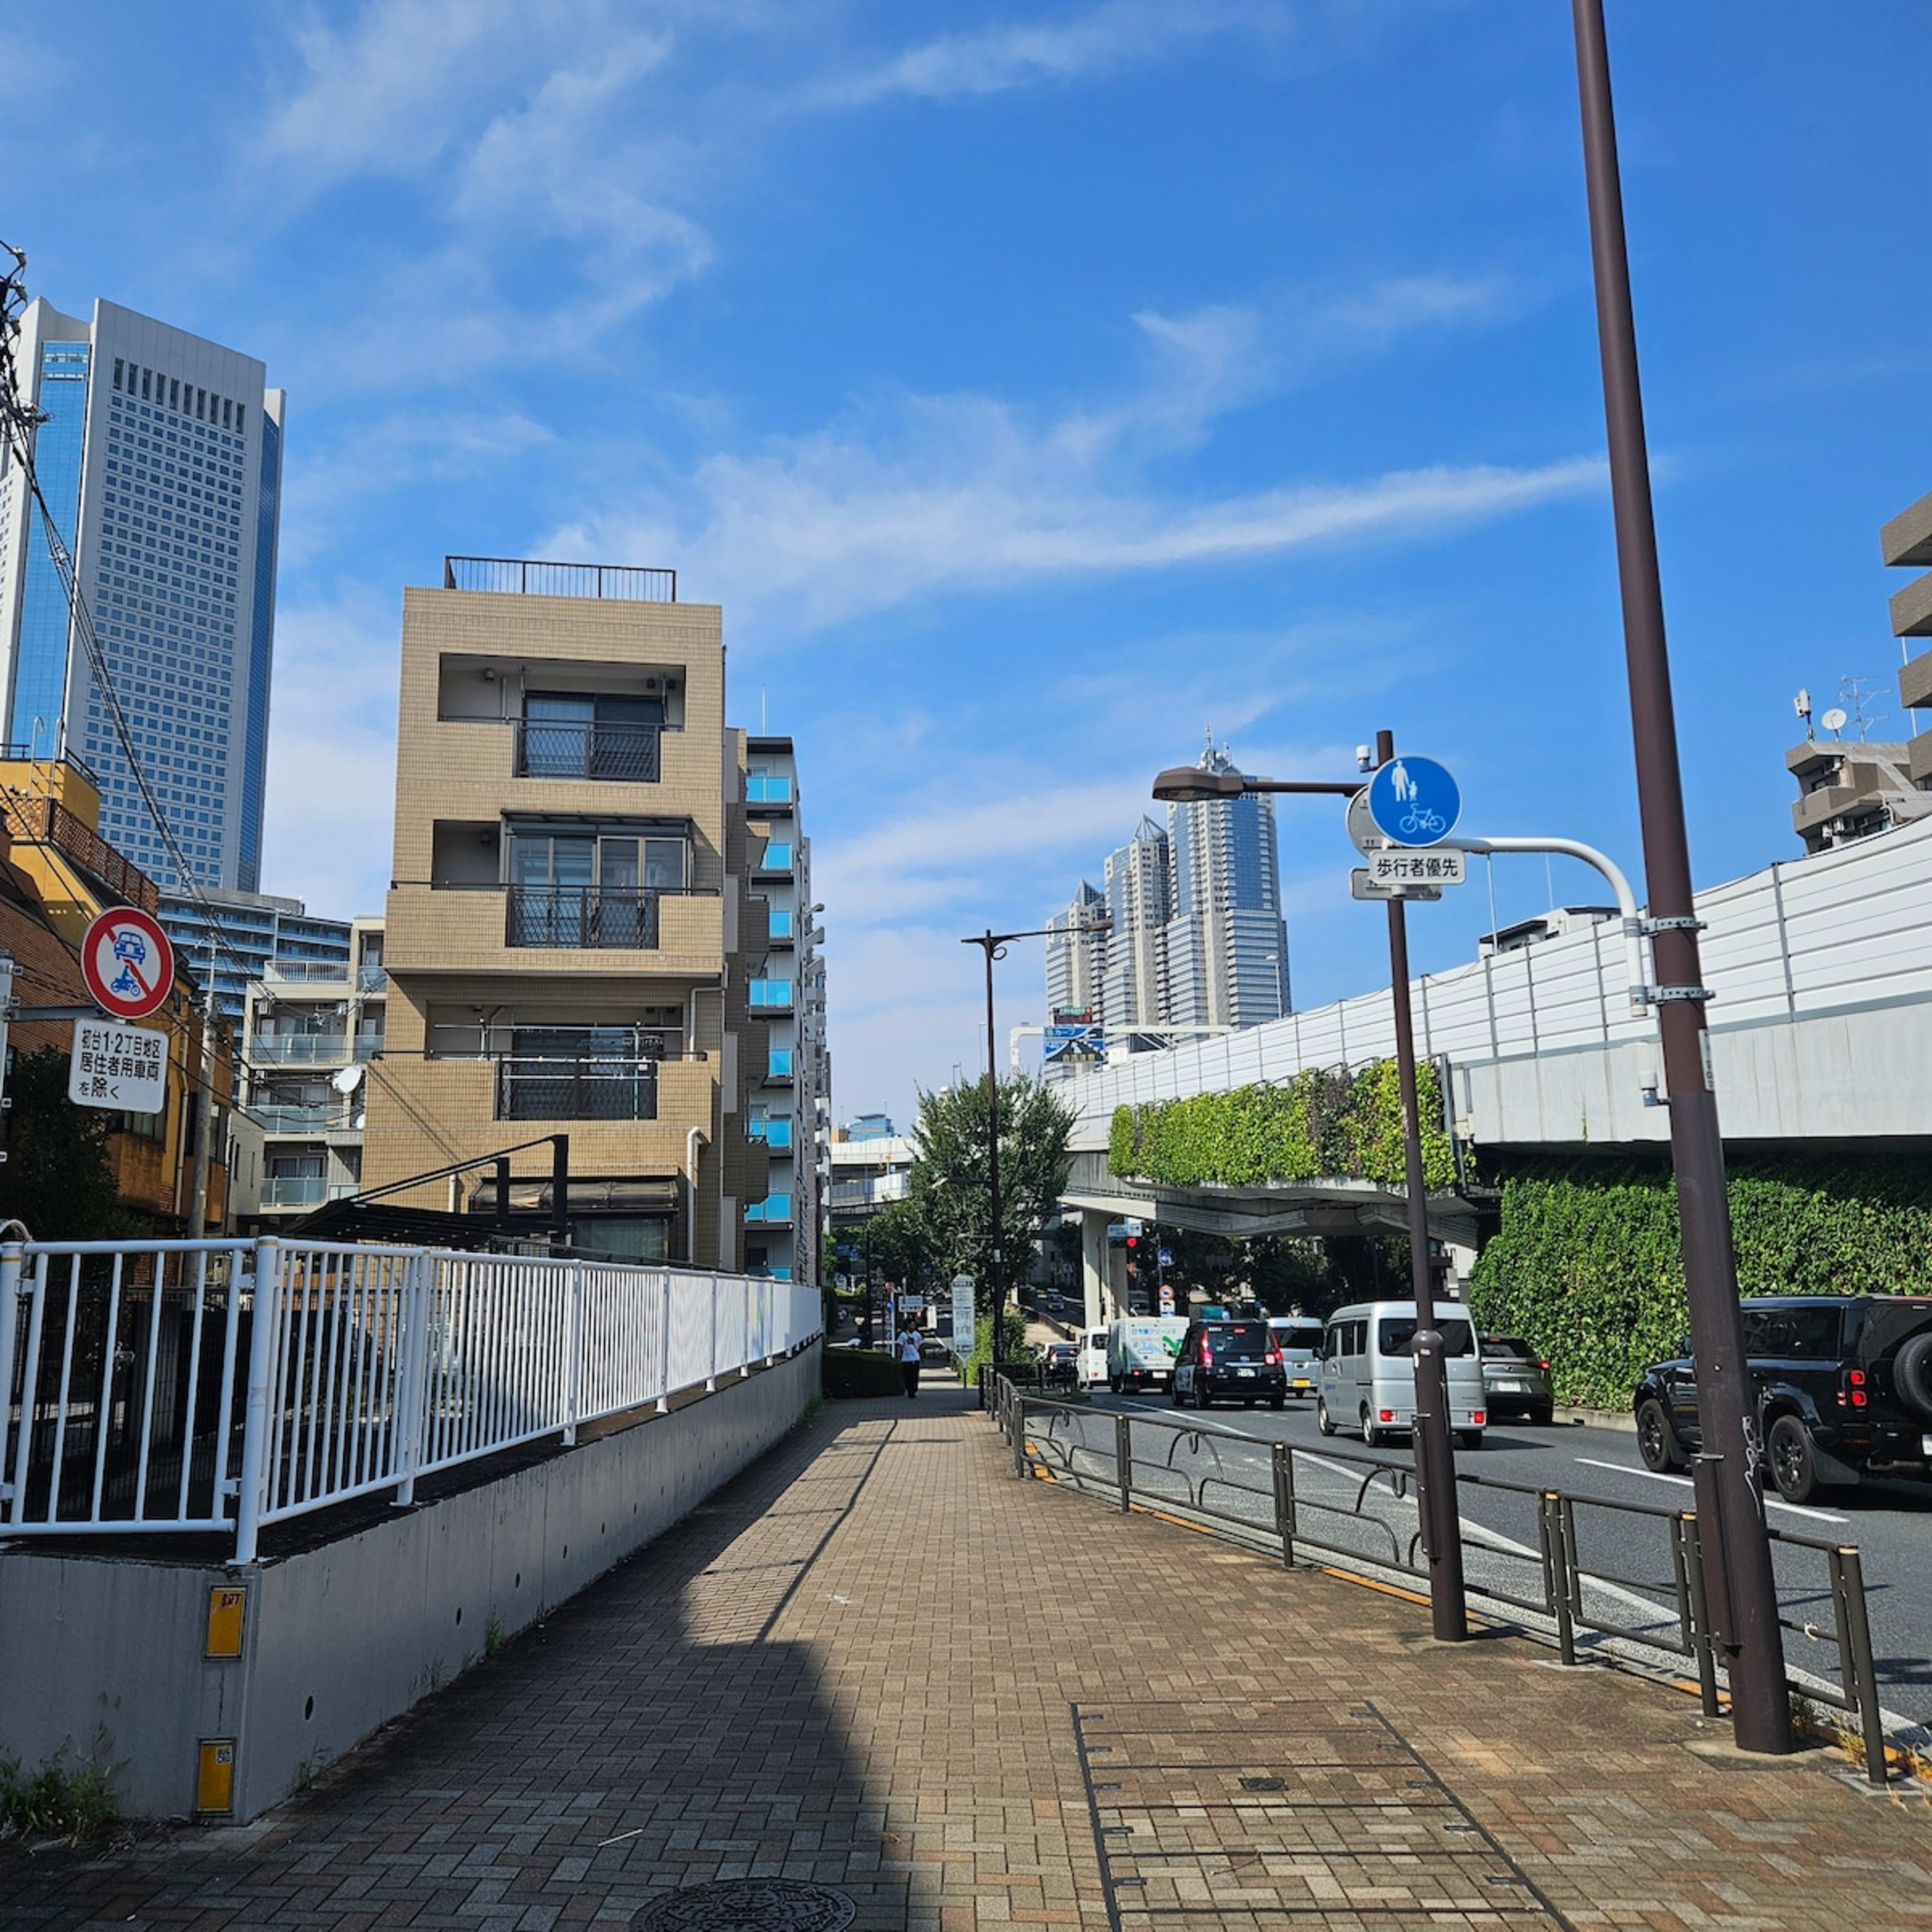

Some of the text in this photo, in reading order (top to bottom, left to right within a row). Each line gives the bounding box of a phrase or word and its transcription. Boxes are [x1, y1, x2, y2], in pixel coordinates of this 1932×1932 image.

[1378, 857, 1459, 877] 歩行者優先
[79, 1052, 160, 1081] 居住者用車両
[79, 1077, 120, 1100] を除く
